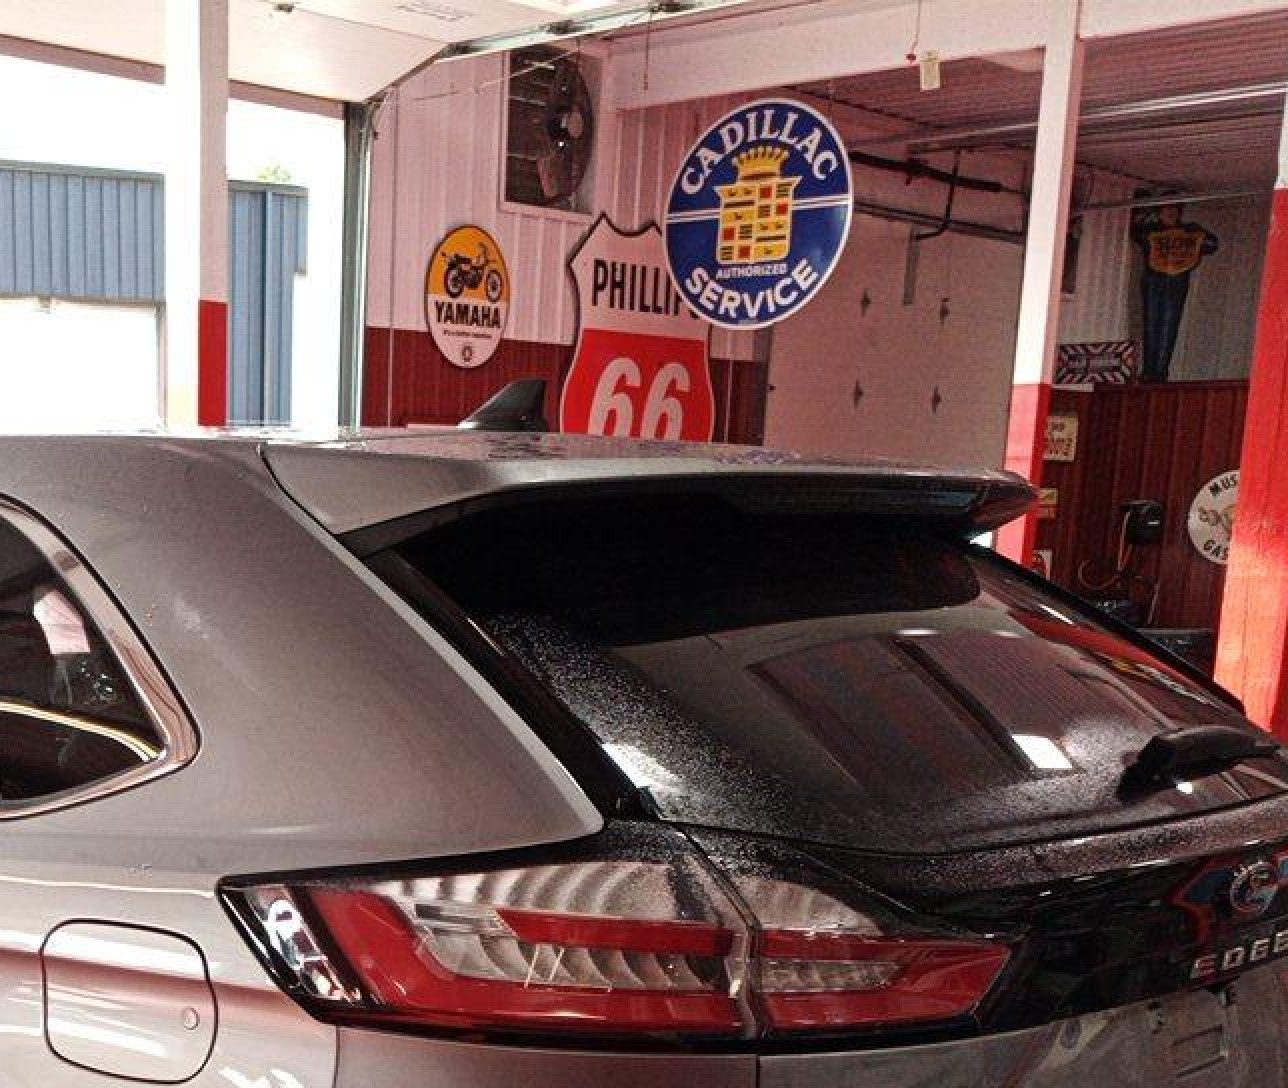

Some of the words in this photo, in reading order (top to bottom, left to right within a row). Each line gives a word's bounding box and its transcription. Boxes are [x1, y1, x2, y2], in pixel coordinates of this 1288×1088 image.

[681, 109, 839, 195] CADILLAC
[592, 258, 698, 319] PHILLI
[685, 258, 819, 319] SERVICE
[716, 263, 789, 279] AUTHORIZED
[434, 299, 501, 328] YAMAHA
[588, 356, 691, 442] 66
[1190, 929, 1288, 979] EDGE
